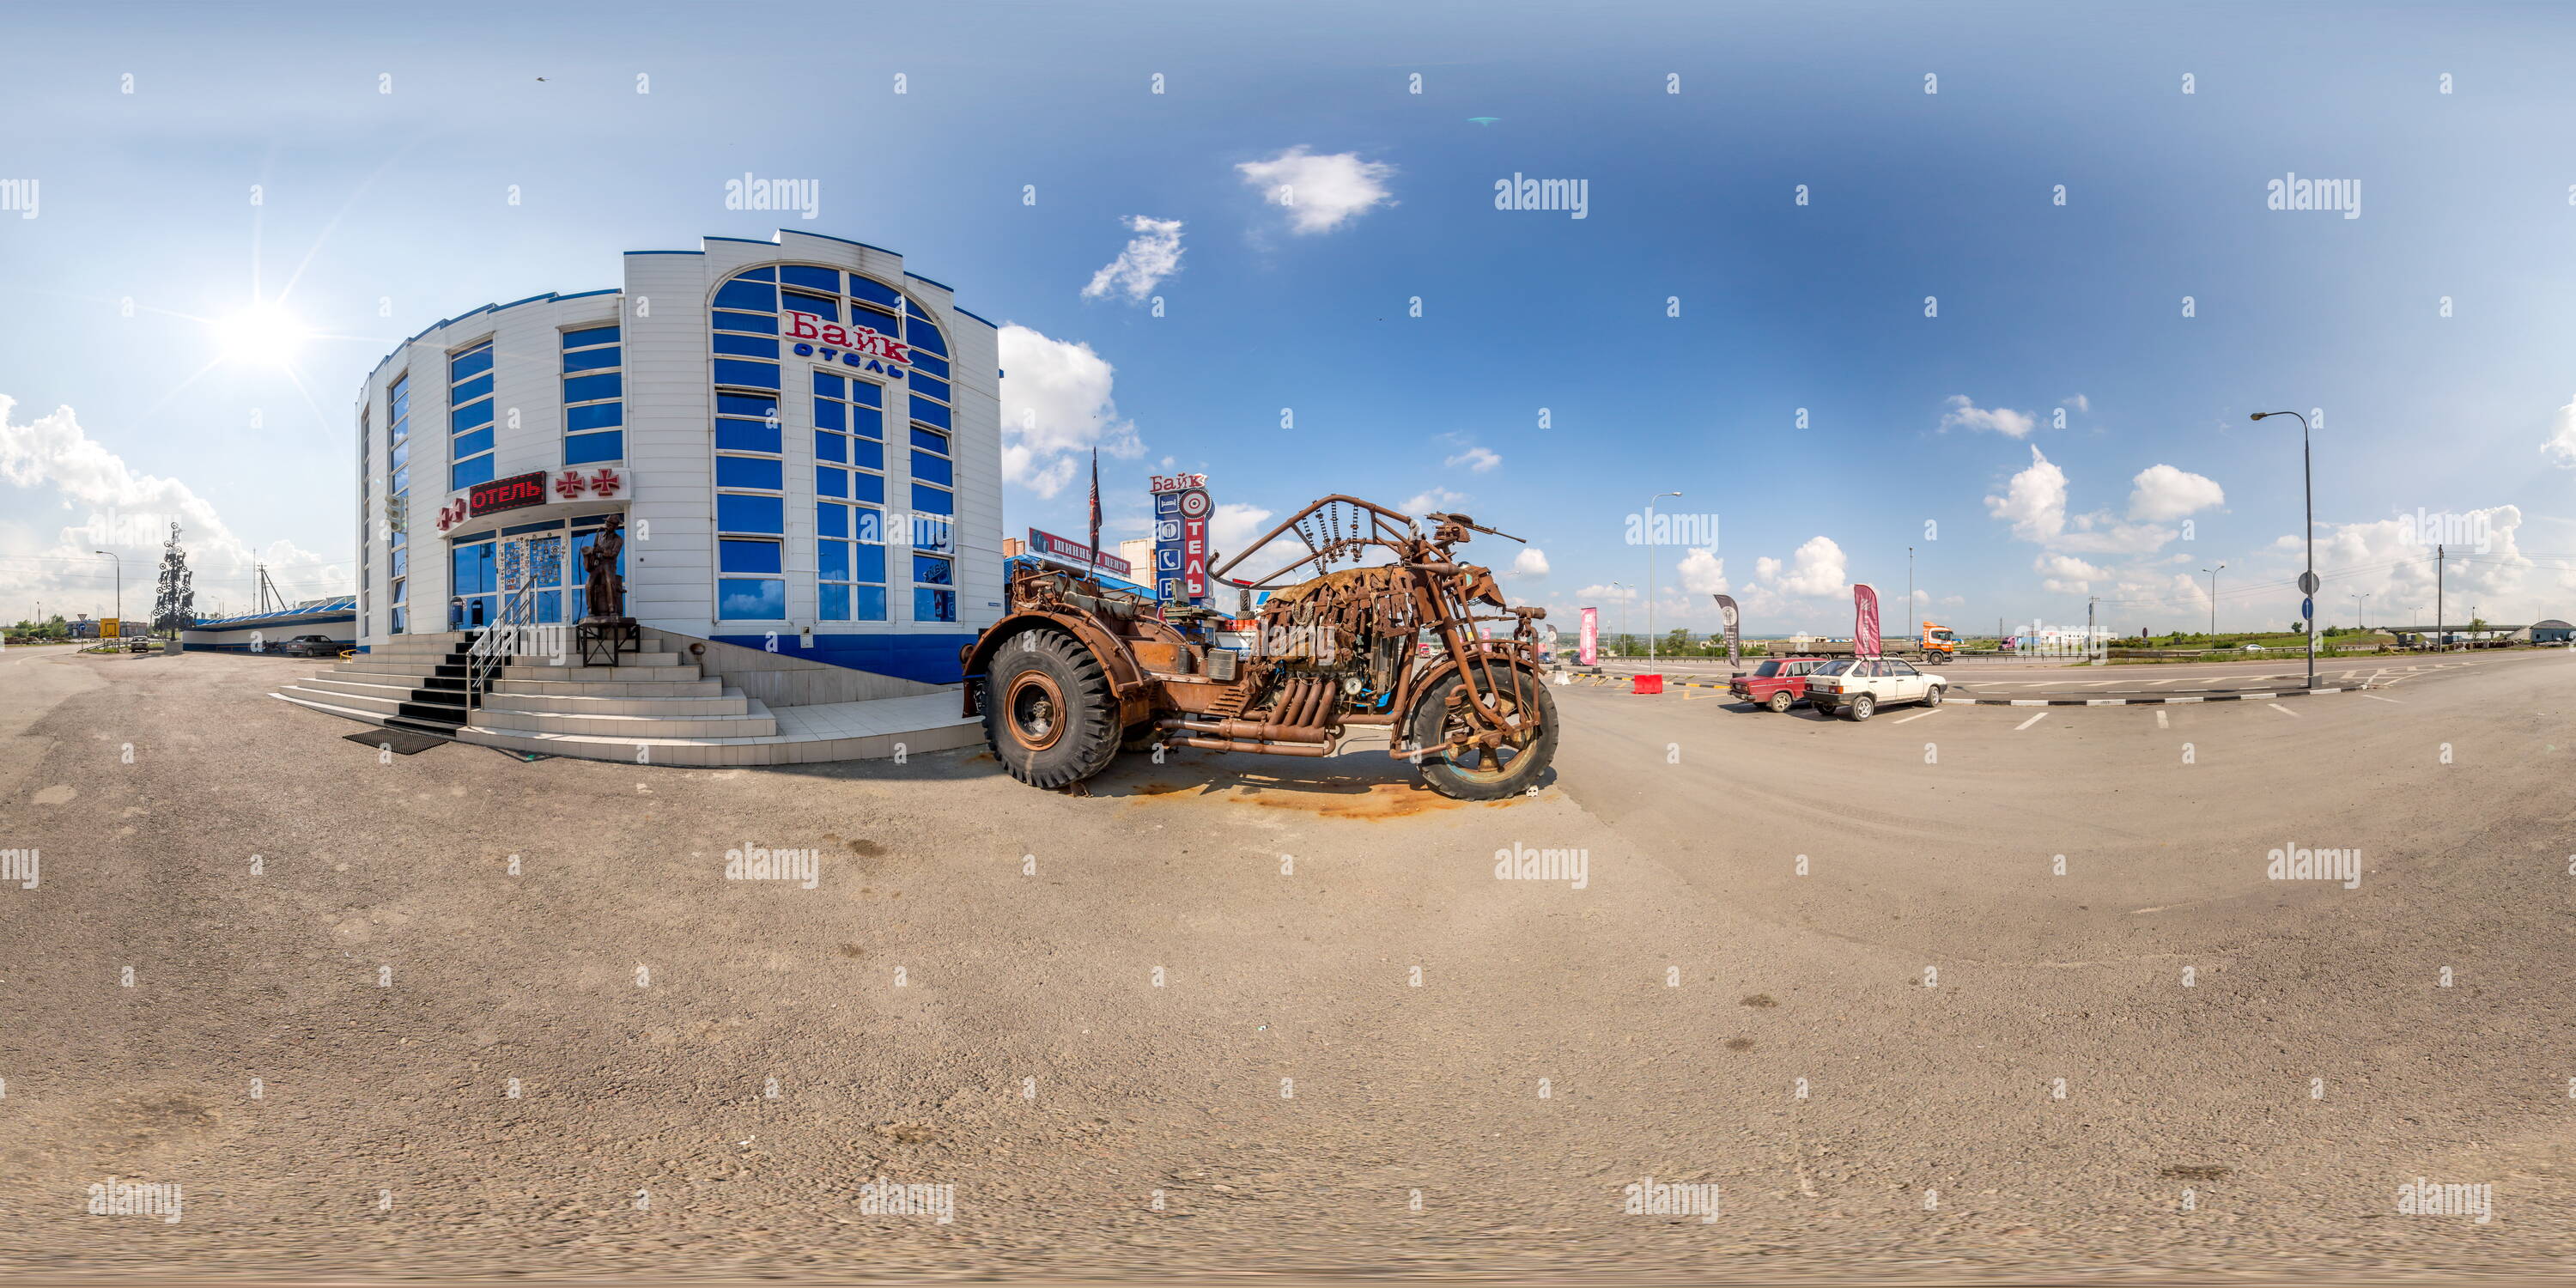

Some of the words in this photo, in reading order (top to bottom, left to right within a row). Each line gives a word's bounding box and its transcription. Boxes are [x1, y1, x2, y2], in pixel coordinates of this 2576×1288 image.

[785, 310, 911, 363] Байк
[1150, 472, 1207, 493] Байк
[471, 482, 541, 508] ОТЕЛЬ
[1104, 556, 1127, 571] ЦЕНТР
